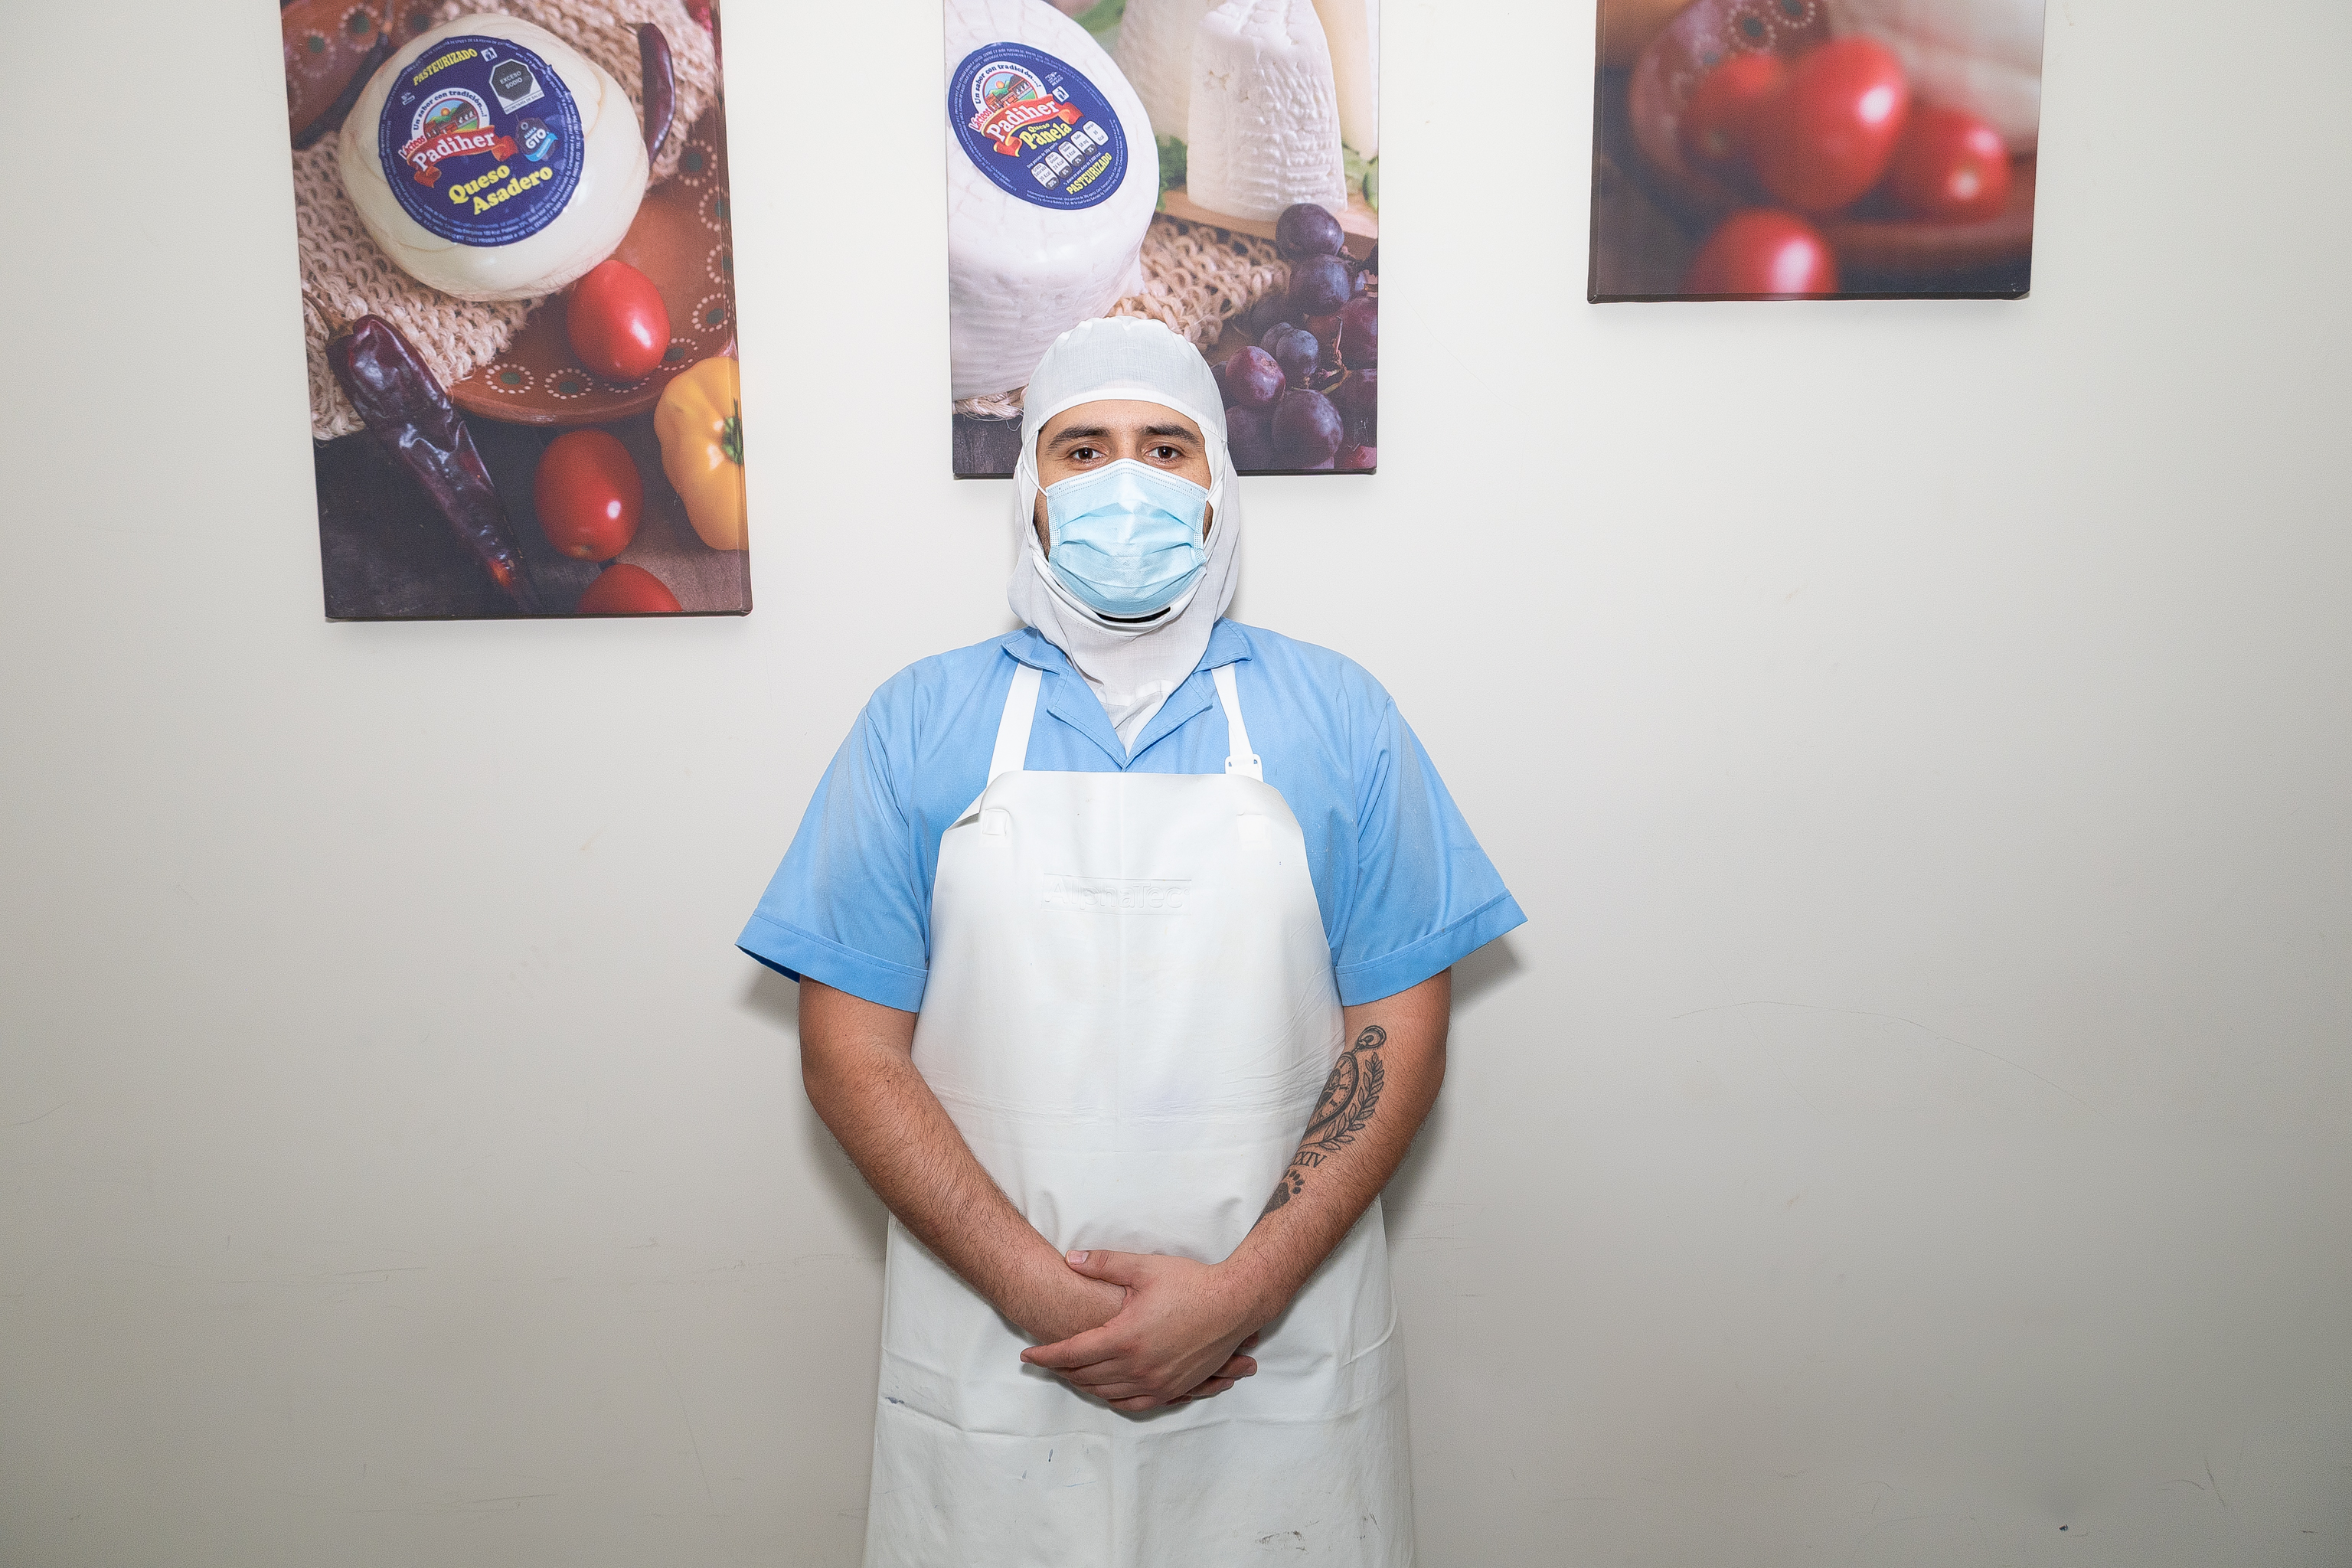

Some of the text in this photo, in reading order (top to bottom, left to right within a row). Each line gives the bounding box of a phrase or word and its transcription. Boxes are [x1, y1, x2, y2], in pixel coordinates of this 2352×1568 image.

[413, 48, 478, 86] PASTEURIZADO
[499, 70, 521, 85] EXCESO
[985, 65, 997, 75] con
[505, 77, 523, 90] SODIO
[975, 73, 986, 93] sabor
[413, 119, 420, 130] Un
[418, 99, 433, 118] sabor
[434, 91, 448, 101] con
[975, 94, 982, 104] Un
[986, 101, 1059, 142] Padiher
[1019, 122, 1072, 150] Panela
[1027, 122, 1050, 133] Queso
[413, 132, 495, 172] Padiher
[525, 129, 547, 149] GTO
[449, 165, 510, 204] Queso
[1066, 152, 1112, 194] PASTEURIZADO
[473, 166, 553, 215] Asadero
[1044, 877, 1183, 910] AlphaTec
